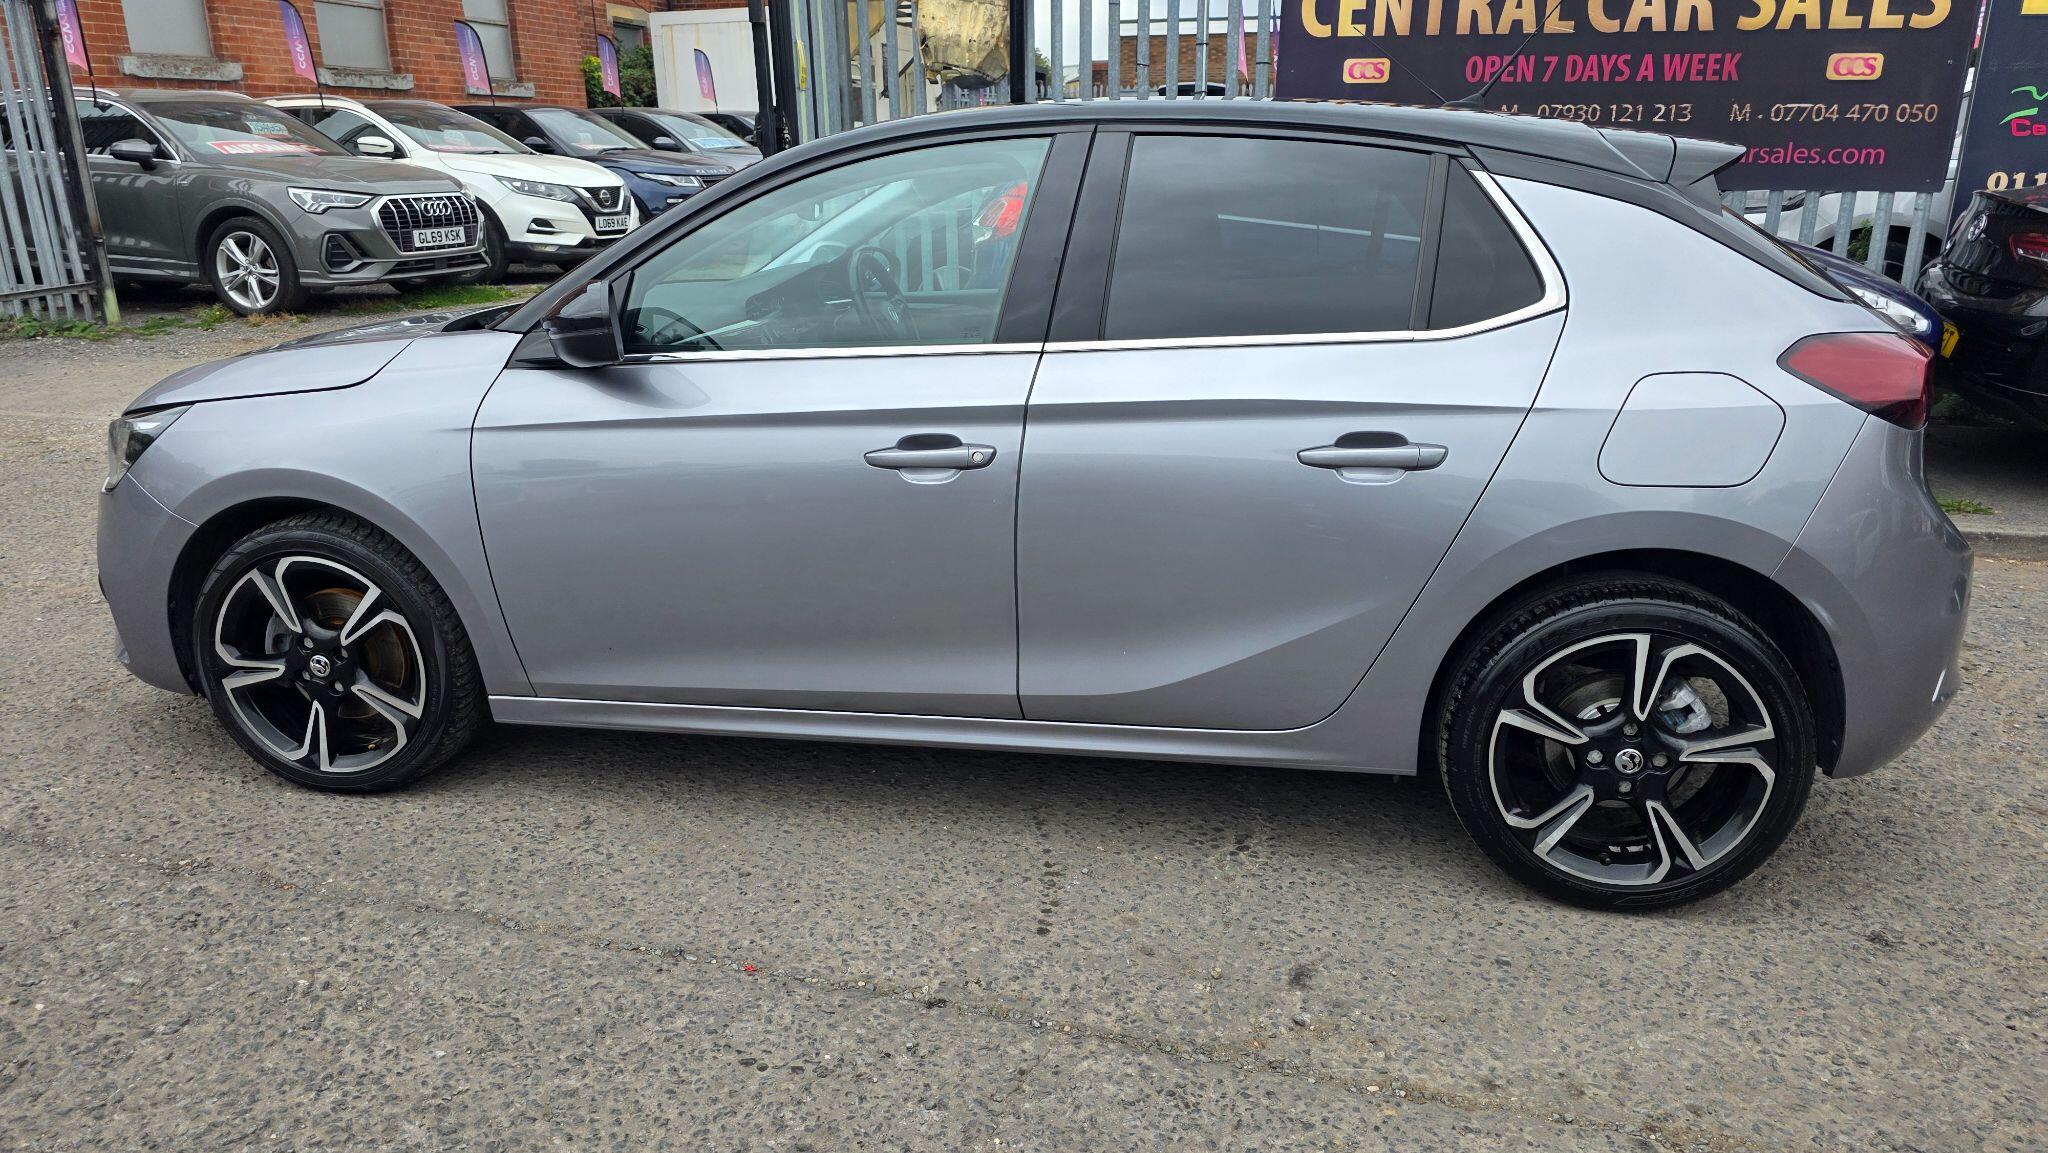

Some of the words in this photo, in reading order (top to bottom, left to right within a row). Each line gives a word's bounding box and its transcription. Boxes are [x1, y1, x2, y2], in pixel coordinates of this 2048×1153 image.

[1301, 0, 1575, 37] CENTRAL
[1587, 0, 1714, 33] CAR
[1348, 61, 1386, 80] CCS
[1465, 55, 1535, 83] OPEN
[1542, 55, 1560, 83] 7
[1564, 54, 1632, 82] DAYS
[1636, 54, 1654, 82] A
[1663, 53, 1743, 82] WEEK
[1833, 56, 1878, 77] CCS
[1537, 104, 1600, 122] 07930
[1609, 104, 1644, 122] 121
[1652, 104, 1693, 122] 213
[1770, 103, 1839, 122] 07704
[1845, 103, 1888, 122] 470
[1895, 103, 1938, 122] 050
[1739, 141, 1886, 165] rsales.com
[418, 230, 443, 244] GL69
[444, 229, 462, 242] KSK
